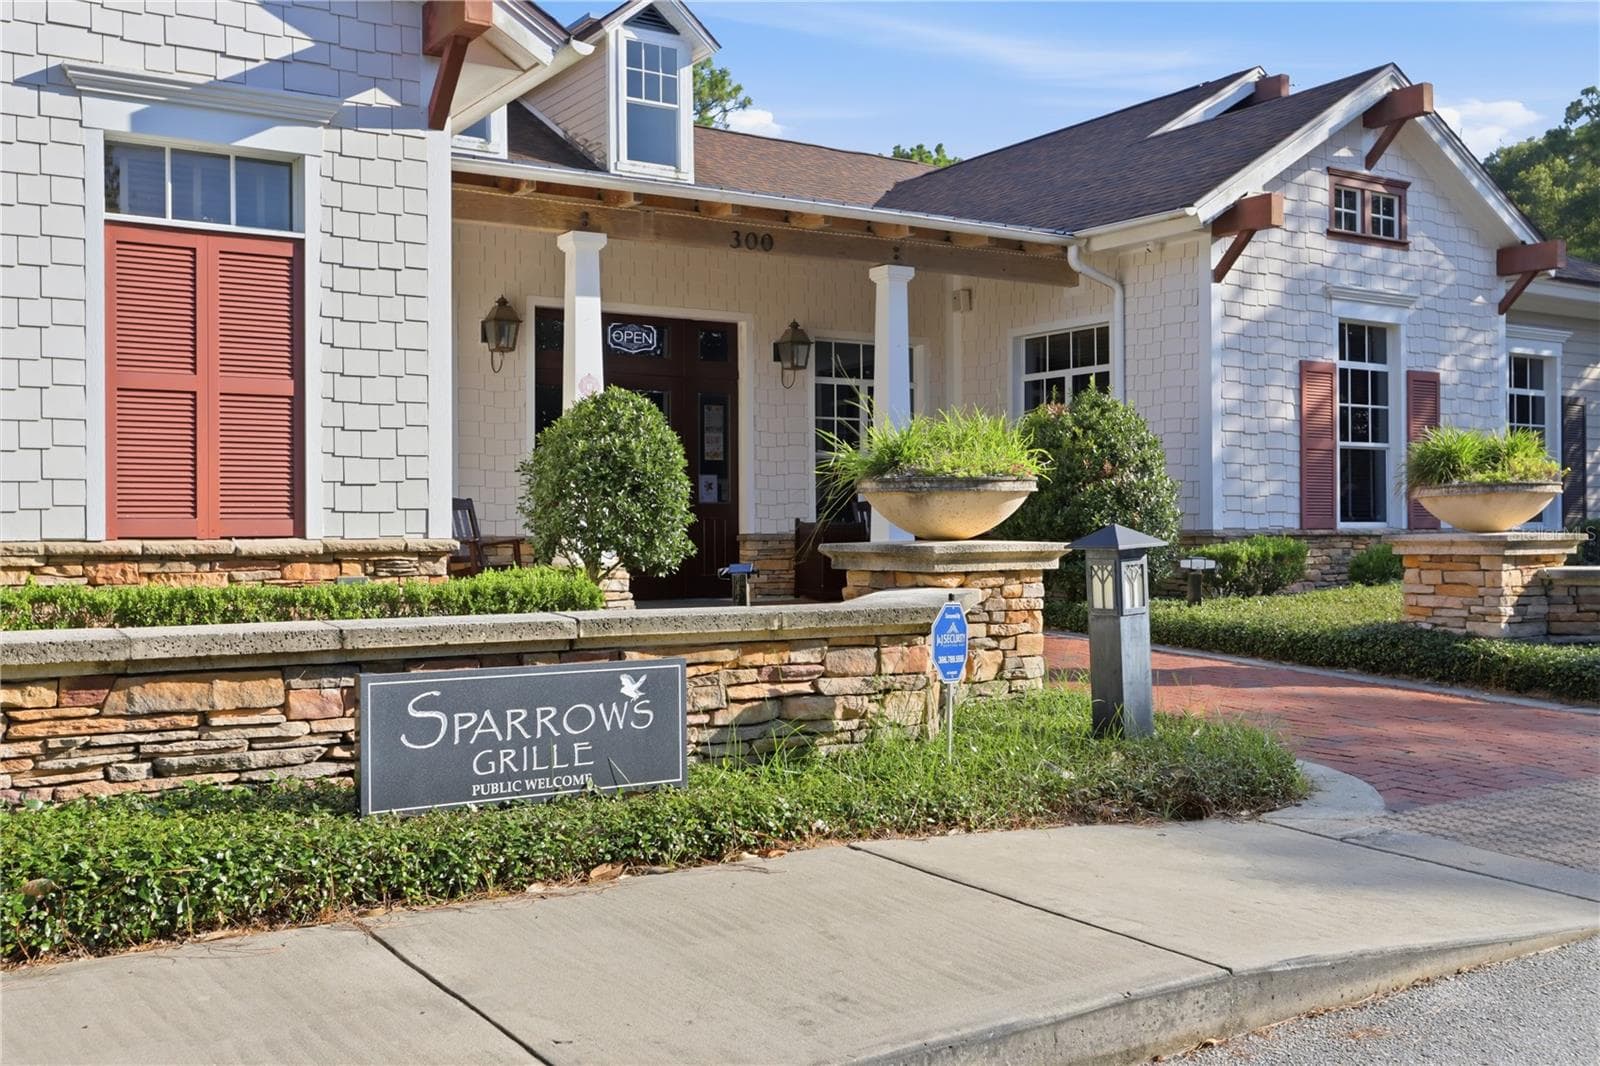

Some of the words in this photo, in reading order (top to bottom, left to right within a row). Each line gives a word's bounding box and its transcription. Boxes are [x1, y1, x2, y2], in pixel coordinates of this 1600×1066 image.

[729, 230, 774, 252] 300
[611, 330, 653, 345] OPEN
[472, 742, 594, 776] GRILLE
[471, 779, 522, 797] PUBLIC
